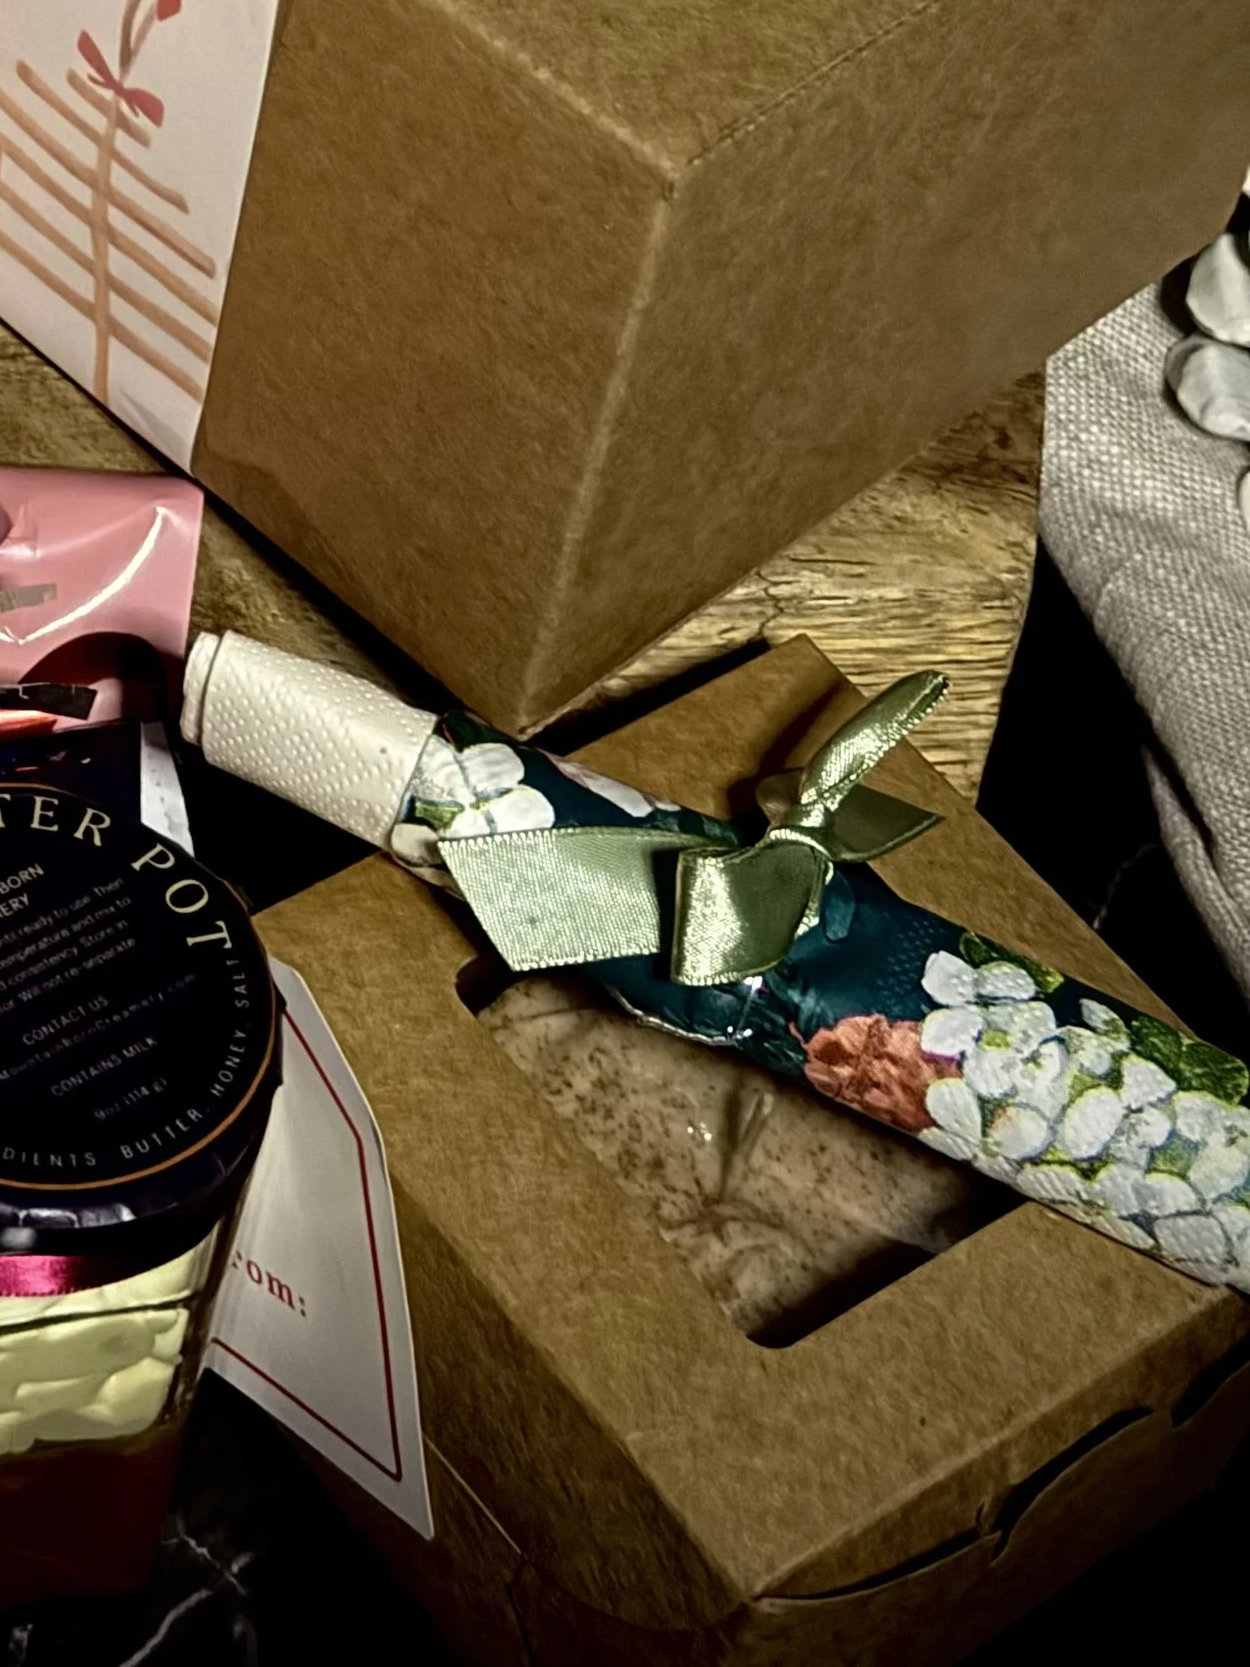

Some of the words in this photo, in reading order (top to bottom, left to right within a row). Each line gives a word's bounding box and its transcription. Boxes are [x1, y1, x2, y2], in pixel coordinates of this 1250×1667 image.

[130, 840, 233, 950] POT
[20, 1004, 87, 1046] CONTACT
[86, 993, 110, 1012] US
[49, 1052, 123, 1096] CONTAINS
